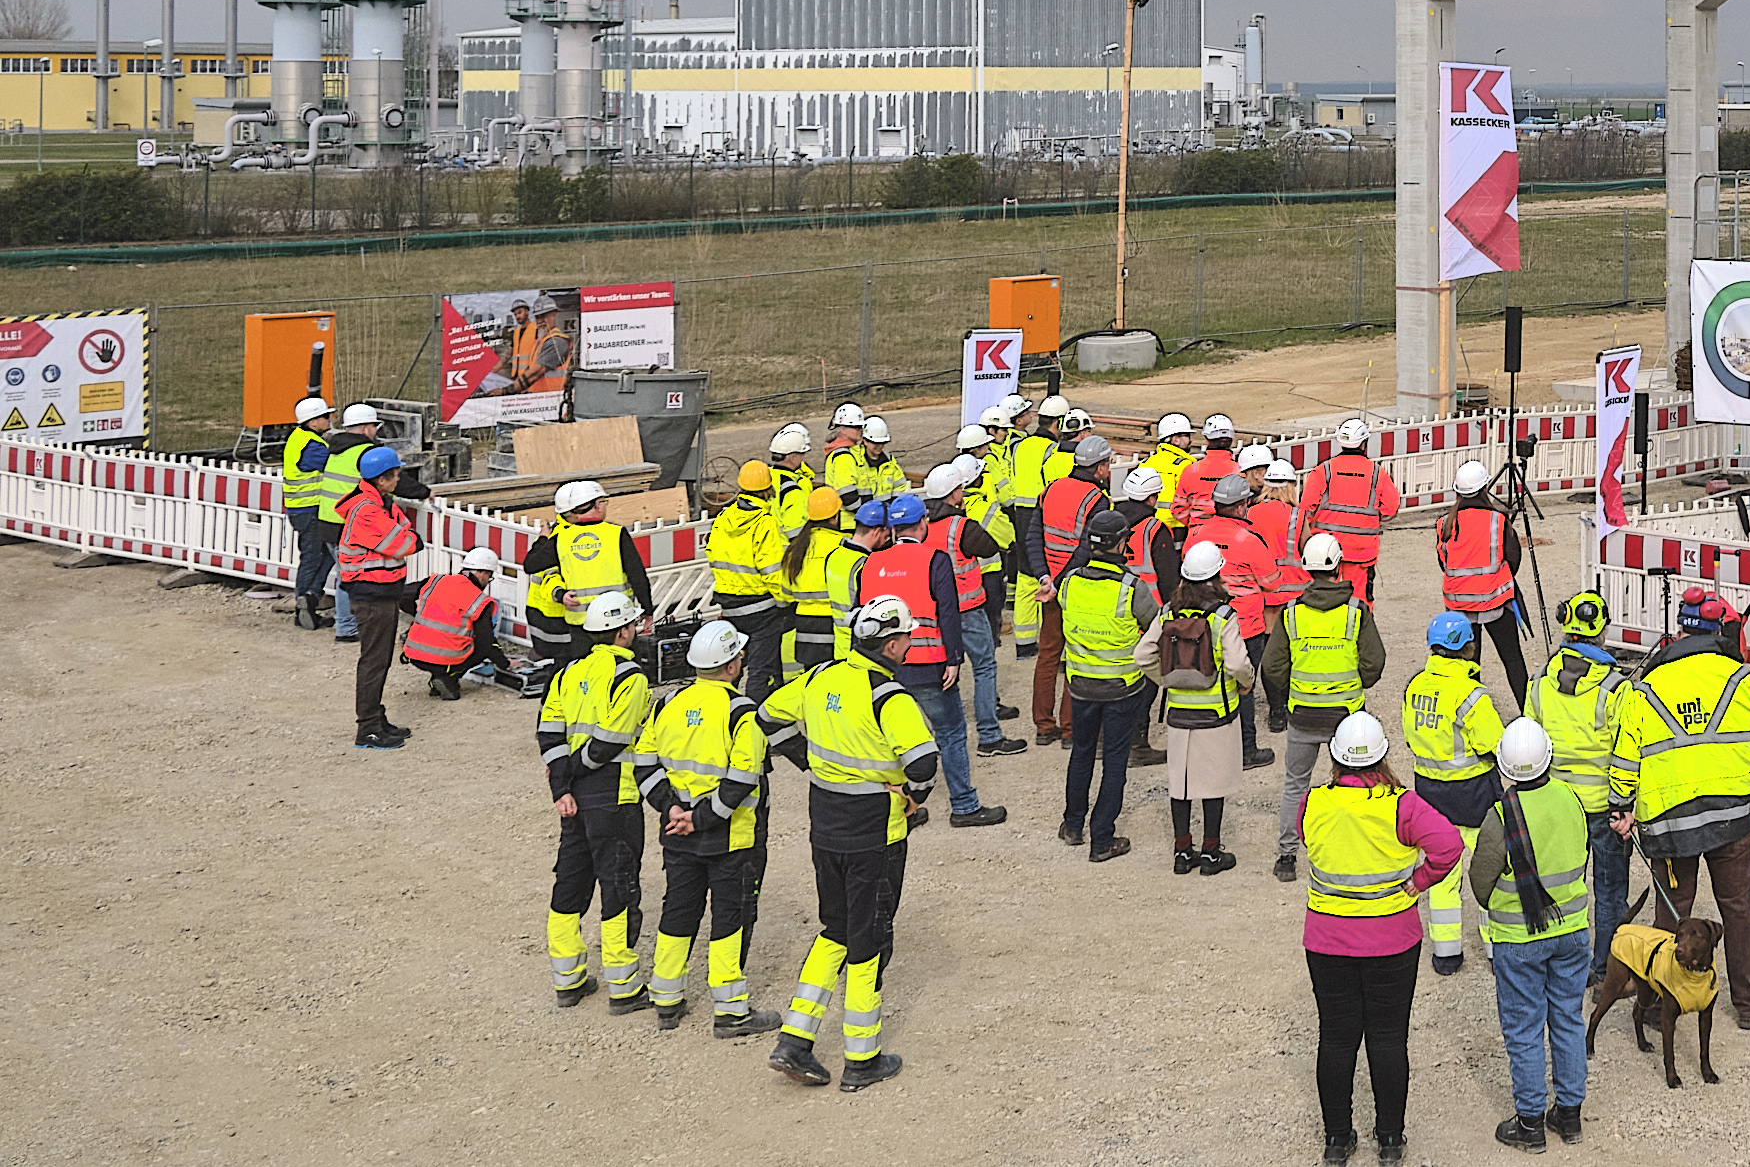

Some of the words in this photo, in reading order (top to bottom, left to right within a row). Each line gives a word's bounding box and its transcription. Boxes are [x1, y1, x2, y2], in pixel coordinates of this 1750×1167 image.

[1450, 117, 1511, 130] KASSECKER
[583, 295, 597, 304] Wir
[597, 293, 632, 303] verstärken
[593, 323, 629, 333] BAULEITER
[593, 339, 646, 350] BAUABRECHNER
[1411, 691, 1439, 713] uni
[1677, 697, 1701, 714] uni
[1415, 710, 1444, 731] per
[1683, 712, 1711, 730] per
